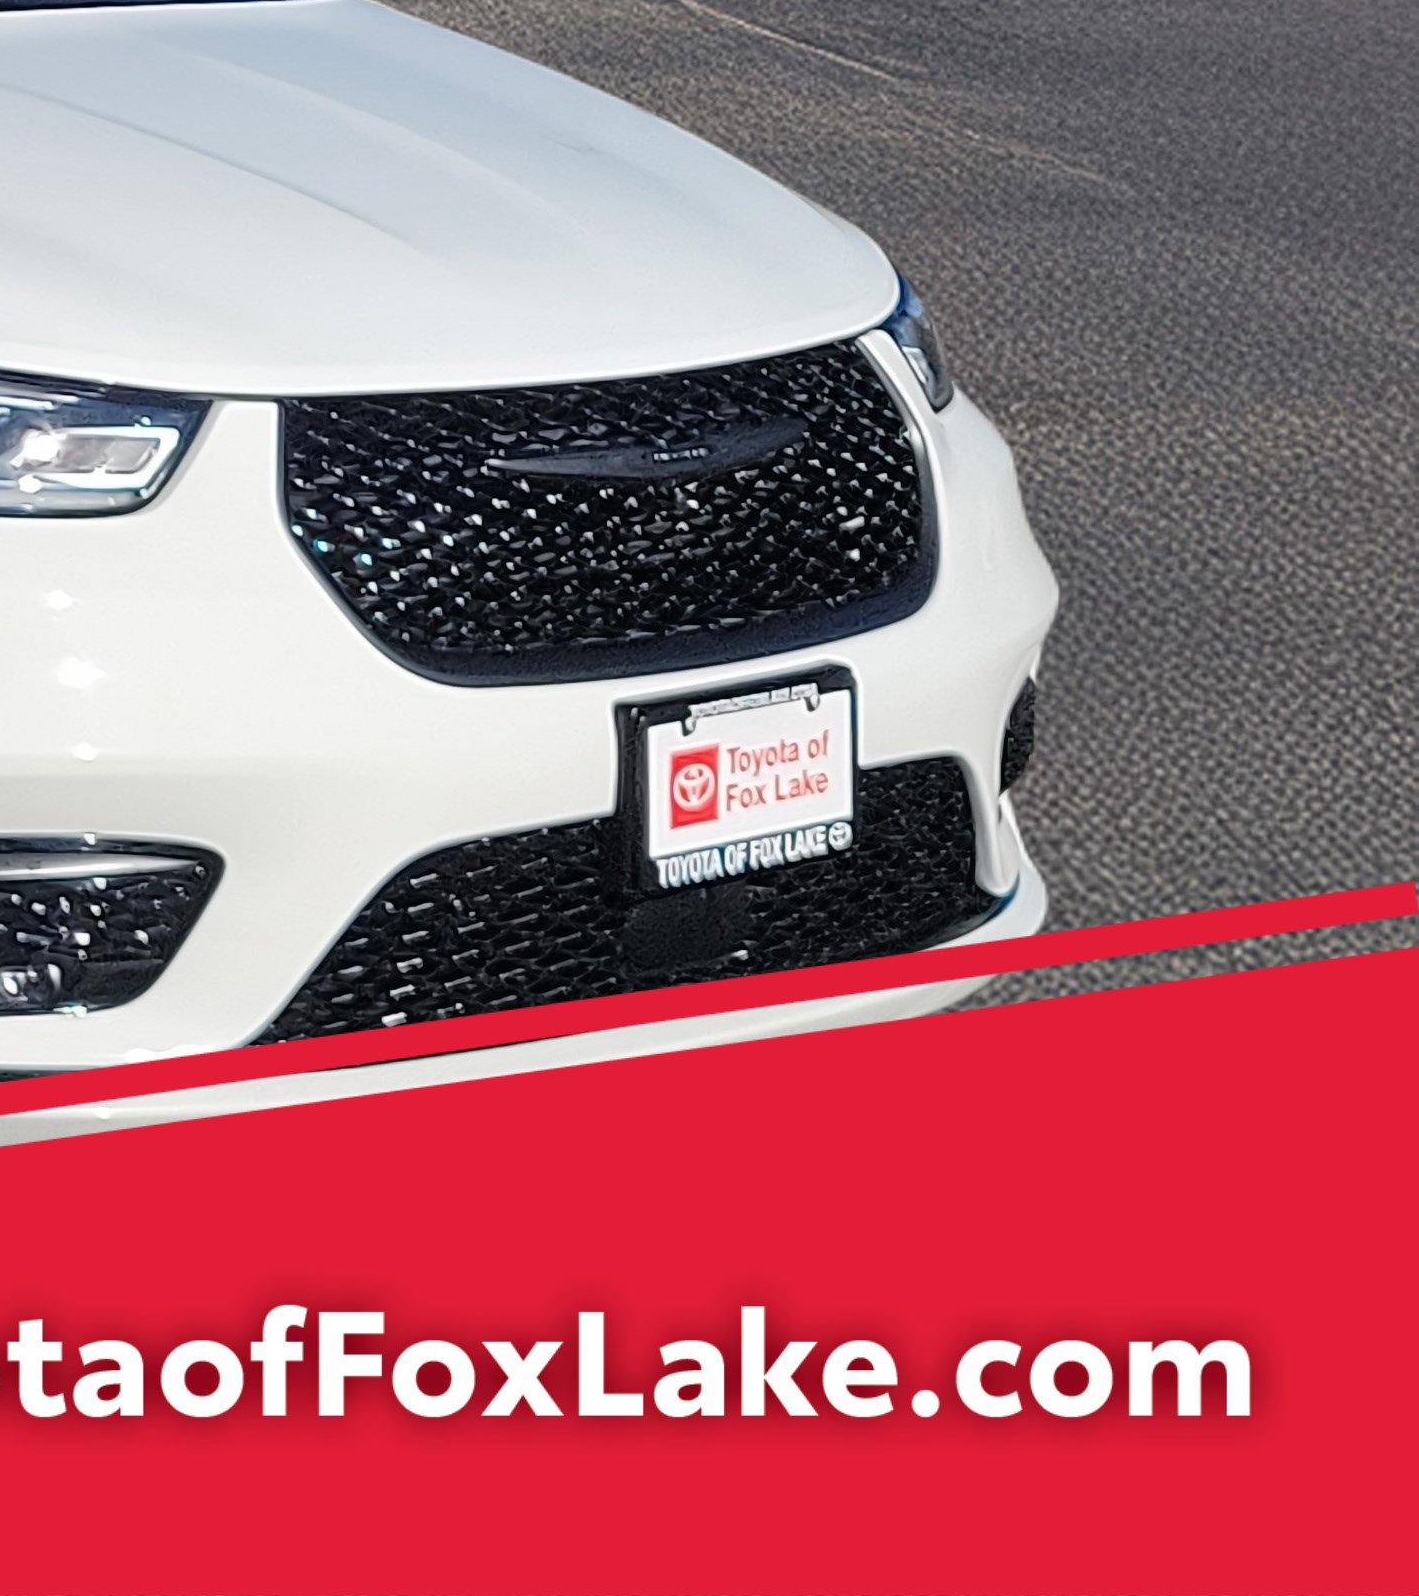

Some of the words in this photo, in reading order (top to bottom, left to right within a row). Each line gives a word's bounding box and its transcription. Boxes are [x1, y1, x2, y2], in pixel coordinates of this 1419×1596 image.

[726, 738, 800, 777] Toyota
[807, 728, 830, 760] of
[725, 783, 767, 812] Fox
[774, 769, 830, 802] Lake
[656, 848, 725, 889] TOYOTA
[723, 842, 750, 876] OF
[749, 834, 786, 871] FOX
[784, 825, 830, 863] LAKE
